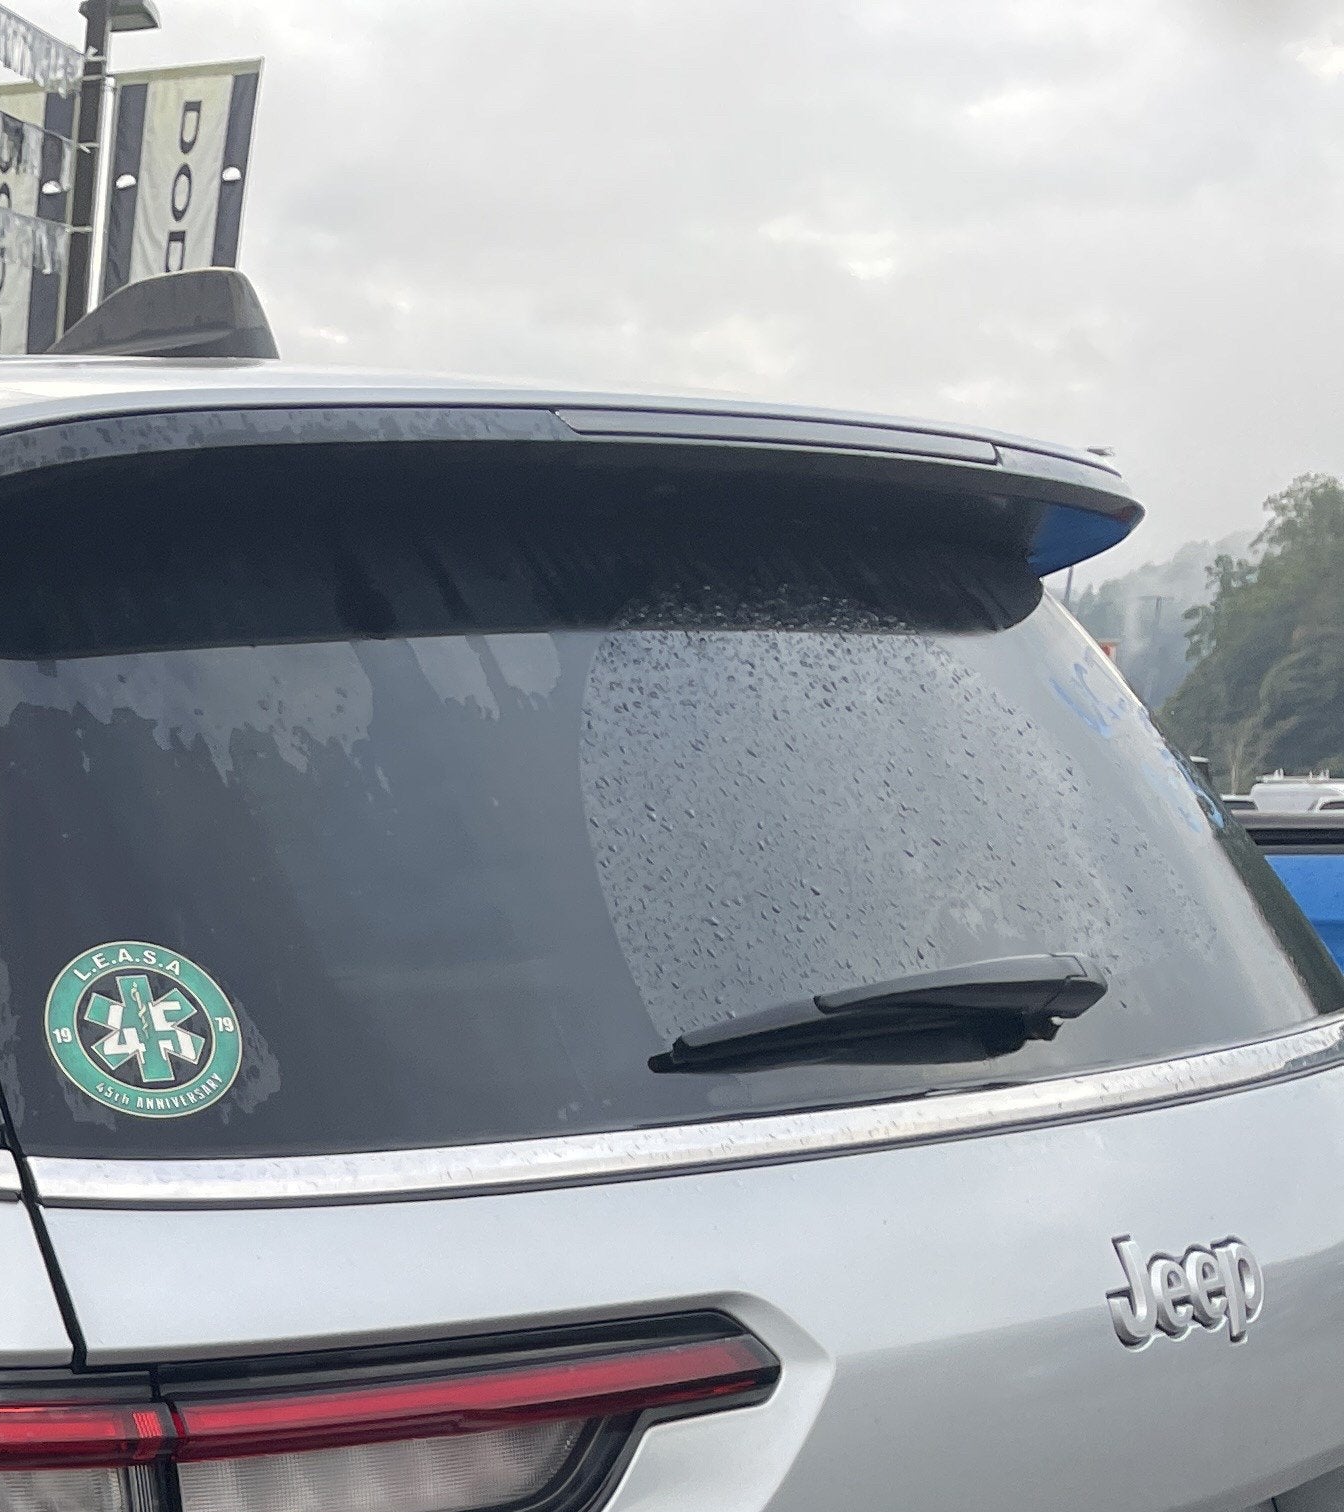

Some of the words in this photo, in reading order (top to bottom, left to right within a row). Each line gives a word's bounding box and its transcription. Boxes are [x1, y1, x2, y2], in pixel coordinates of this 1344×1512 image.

[52, 1027, 73, 1044] 19
[215, 1016, 235, 1033] 79
[136, 1072, 224, 1111] ANNIVERSARY
[1106, 1233, 1265, 1352] Jeep
